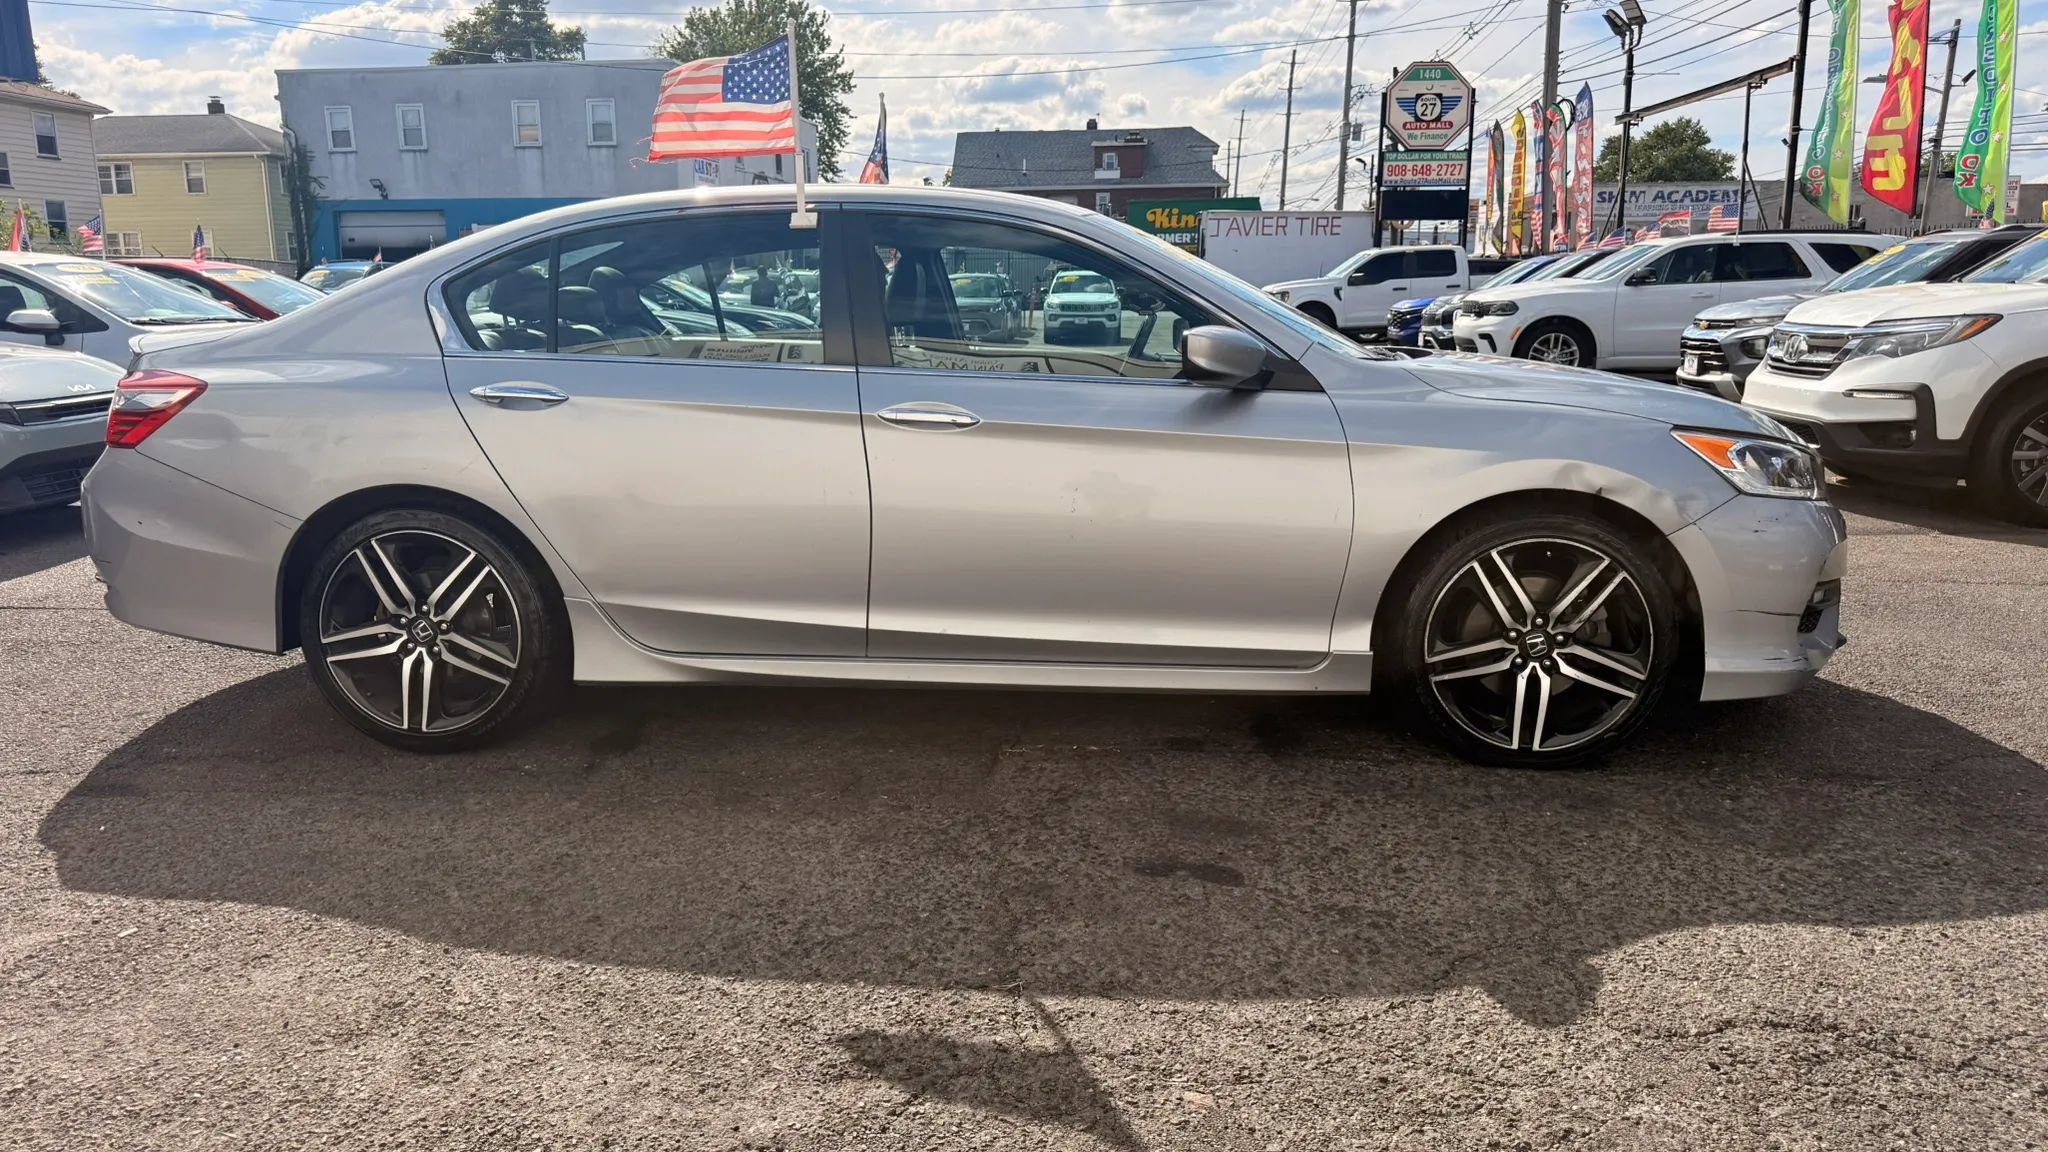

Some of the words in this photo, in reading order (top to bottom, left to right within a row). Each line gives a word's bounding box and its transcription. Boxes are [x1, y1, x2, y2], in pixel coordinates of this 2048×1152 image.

[1420, 69, 1441, 79] 1440
[1420, 103, 1437, 117] 27
[1405, 122, 1427, 130] AUTO
[1429, 121, 1451, 129] MALL
[1407, 132, 1419, 140] We
[1420, 131, 1449, 140] Finance
[1398, 152, 1418, 160] DOLLAR
[1420, 152, 1431, 160] FOR
[1432, 152, 1448, 160] YOUR
[1387, 163, 1464, 177] 908-648-2727
[1146, 207, 1200, 229] Kin
[1208, 216, 1289, 238] JAVIER
[1295, 216, 1342, 237] TIRE
